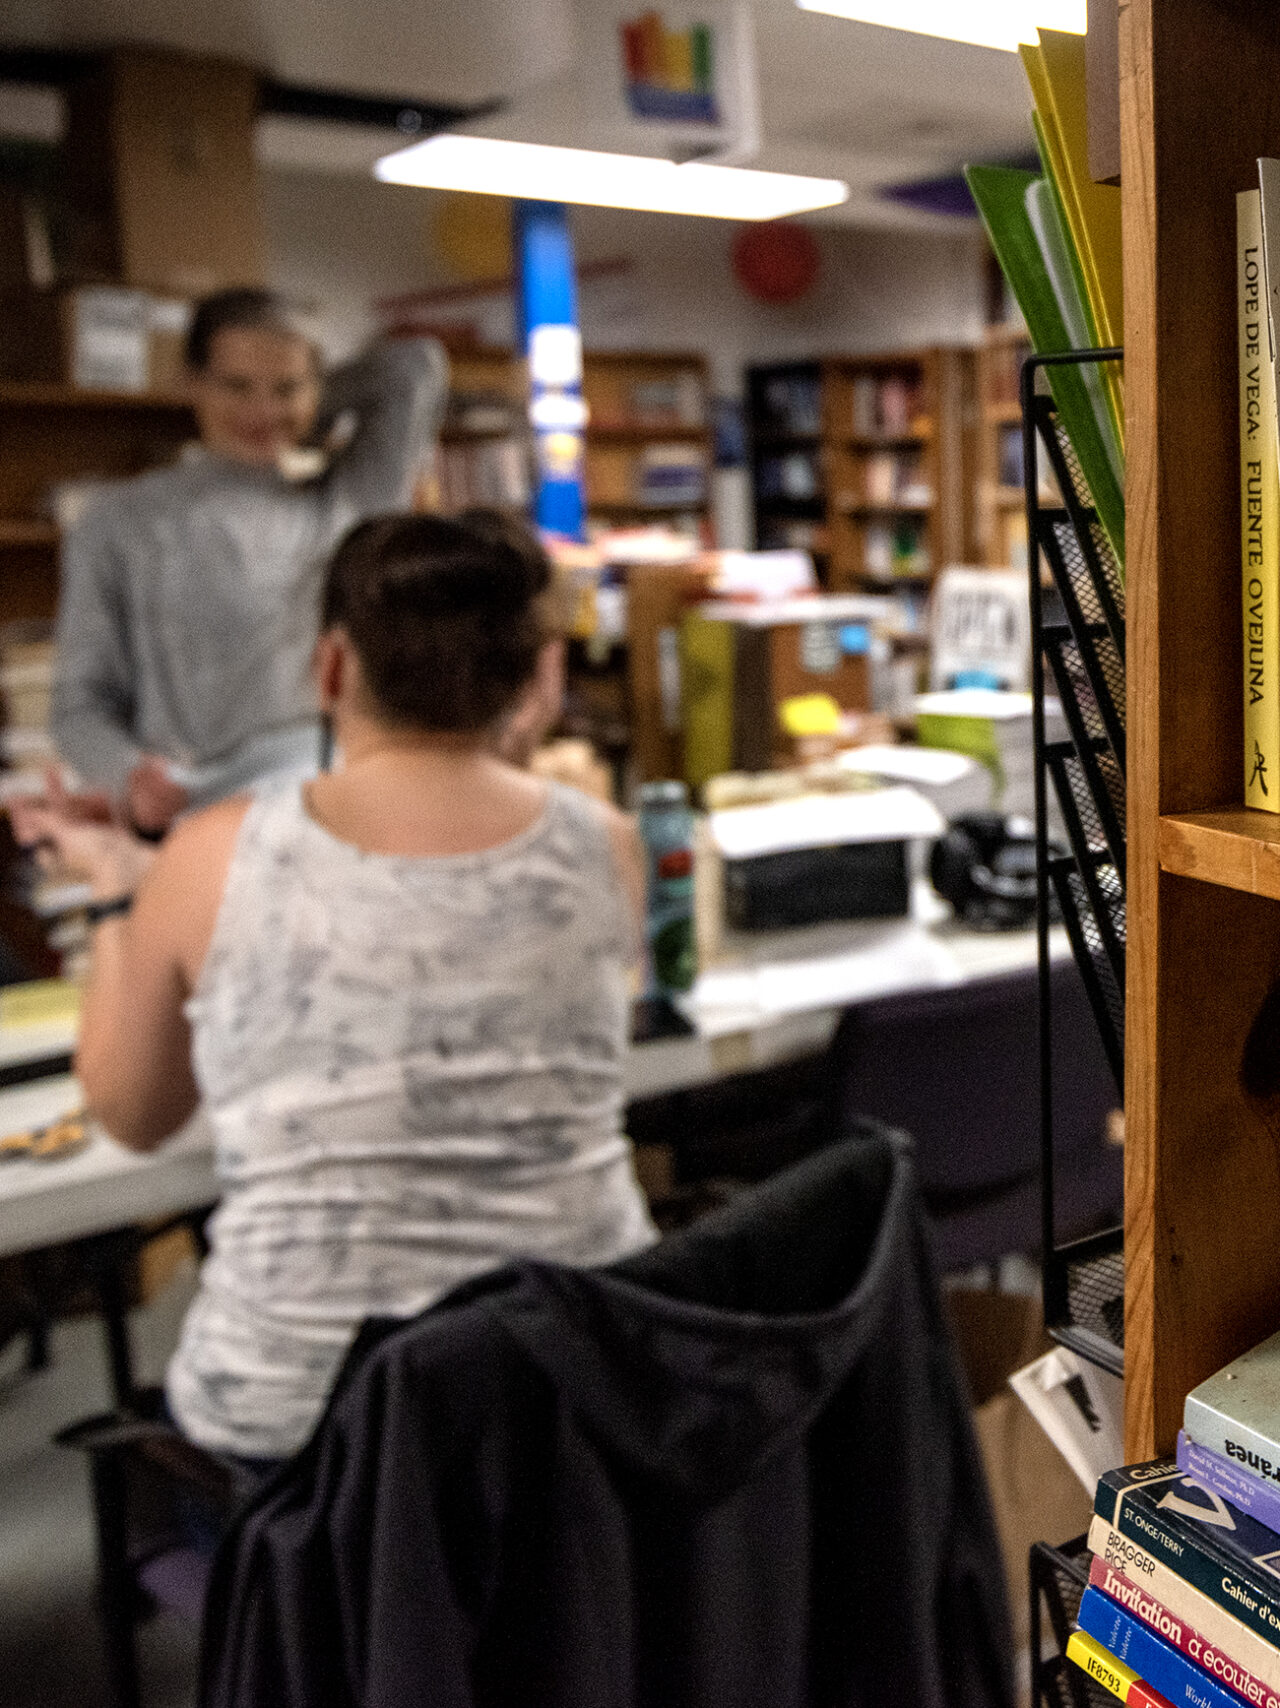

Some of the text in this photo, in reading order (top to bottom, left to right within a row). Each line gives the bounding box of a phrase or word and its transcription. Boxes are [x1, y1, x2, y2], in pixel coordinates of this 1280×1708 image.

[1245, 246, 1264, 706] LOPE DE VEGA: FUENTE OVEJUNA
[1130, 1463, 1178, 1480] Cahie
[1124, 1507, 1185, 1558] ST. ONGE/TERRY
[1104, 1550, 1128, 1575] RICE
[1107, 1531, 1157, 1577] BRAGGER
[1221, 1577, 1257, 1611] Cahier
[1103, 1570, 1183, 1645] Invitation
[1188, 1628, 1206, 1657] à
[1202, 1641, 1268, 1704] écouter
[1086, 1656, 1121, 1693] IF8793
